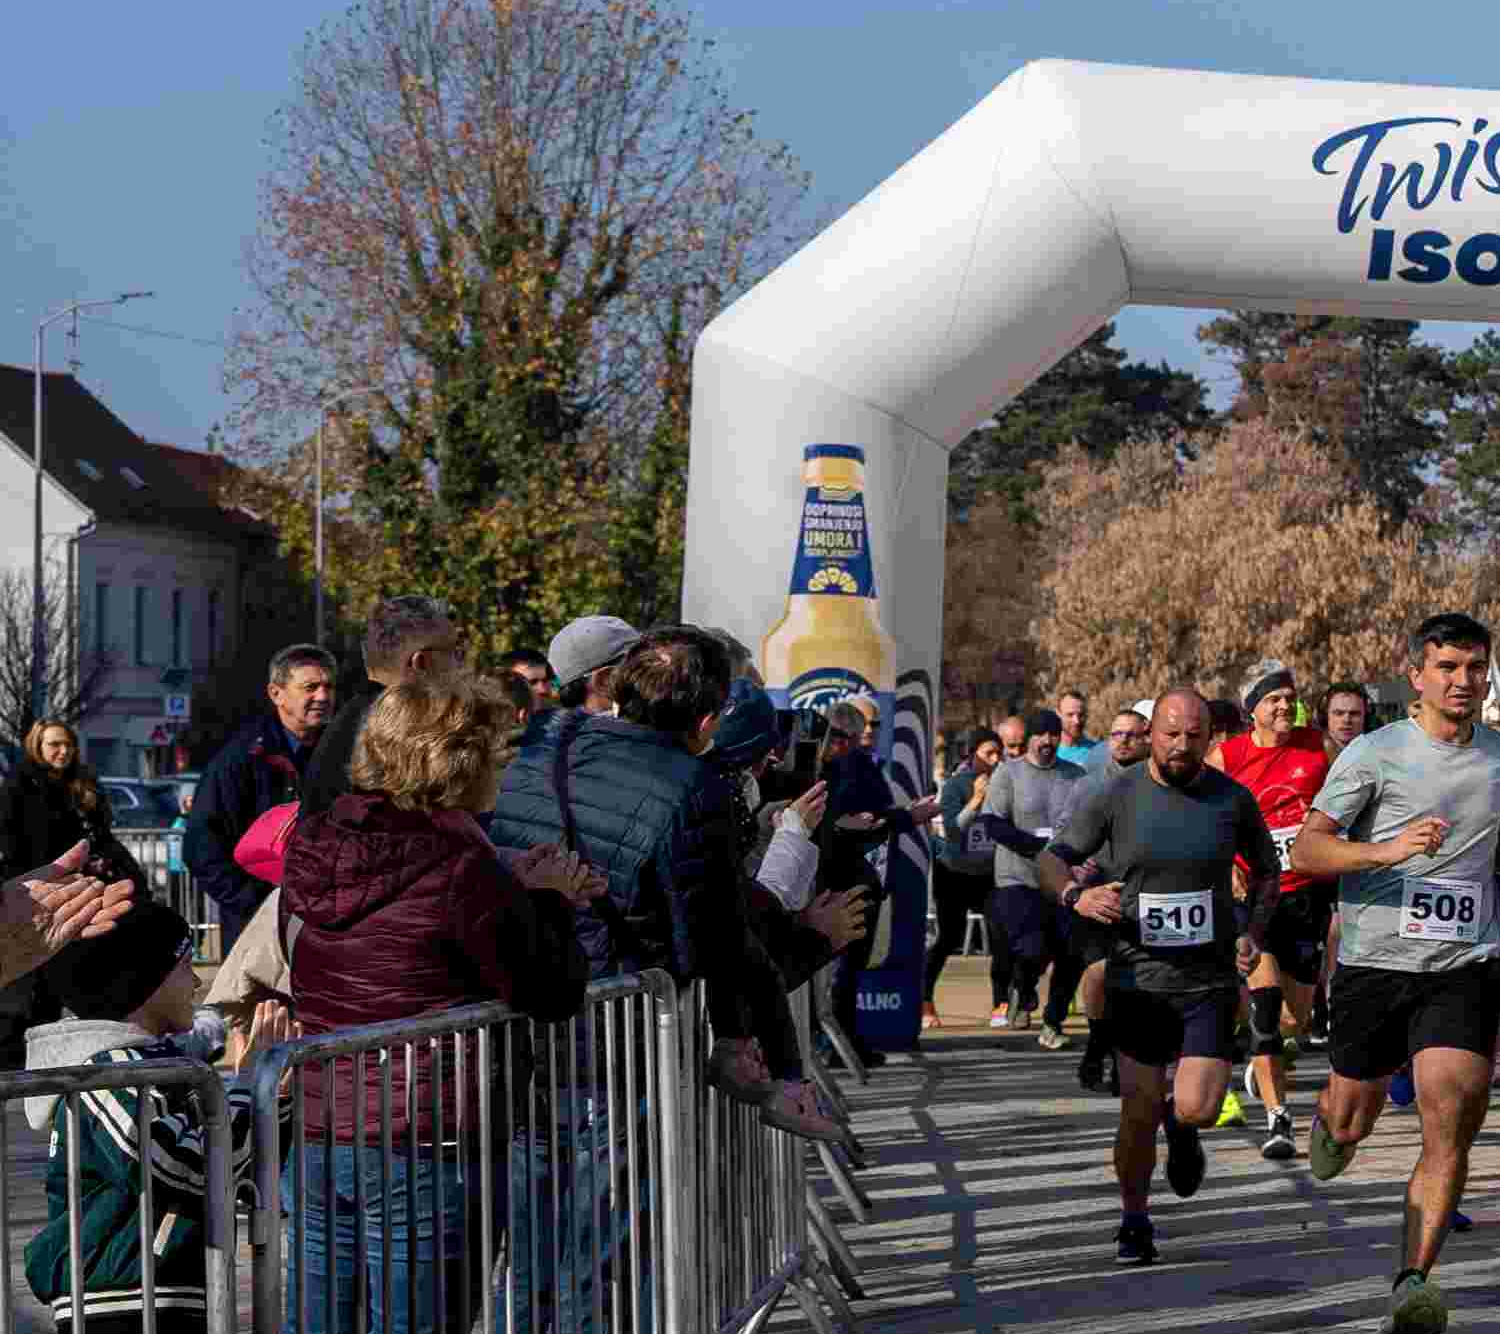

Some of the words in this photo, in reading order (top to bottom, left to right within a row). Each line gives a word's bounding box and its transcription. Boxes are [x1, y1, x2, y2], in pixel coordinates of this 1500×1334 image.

[1147, 904, 1206, 930] 510
[1410, 892, 1475, 924] 508
[856, 992, 902, 1011] ALNO
